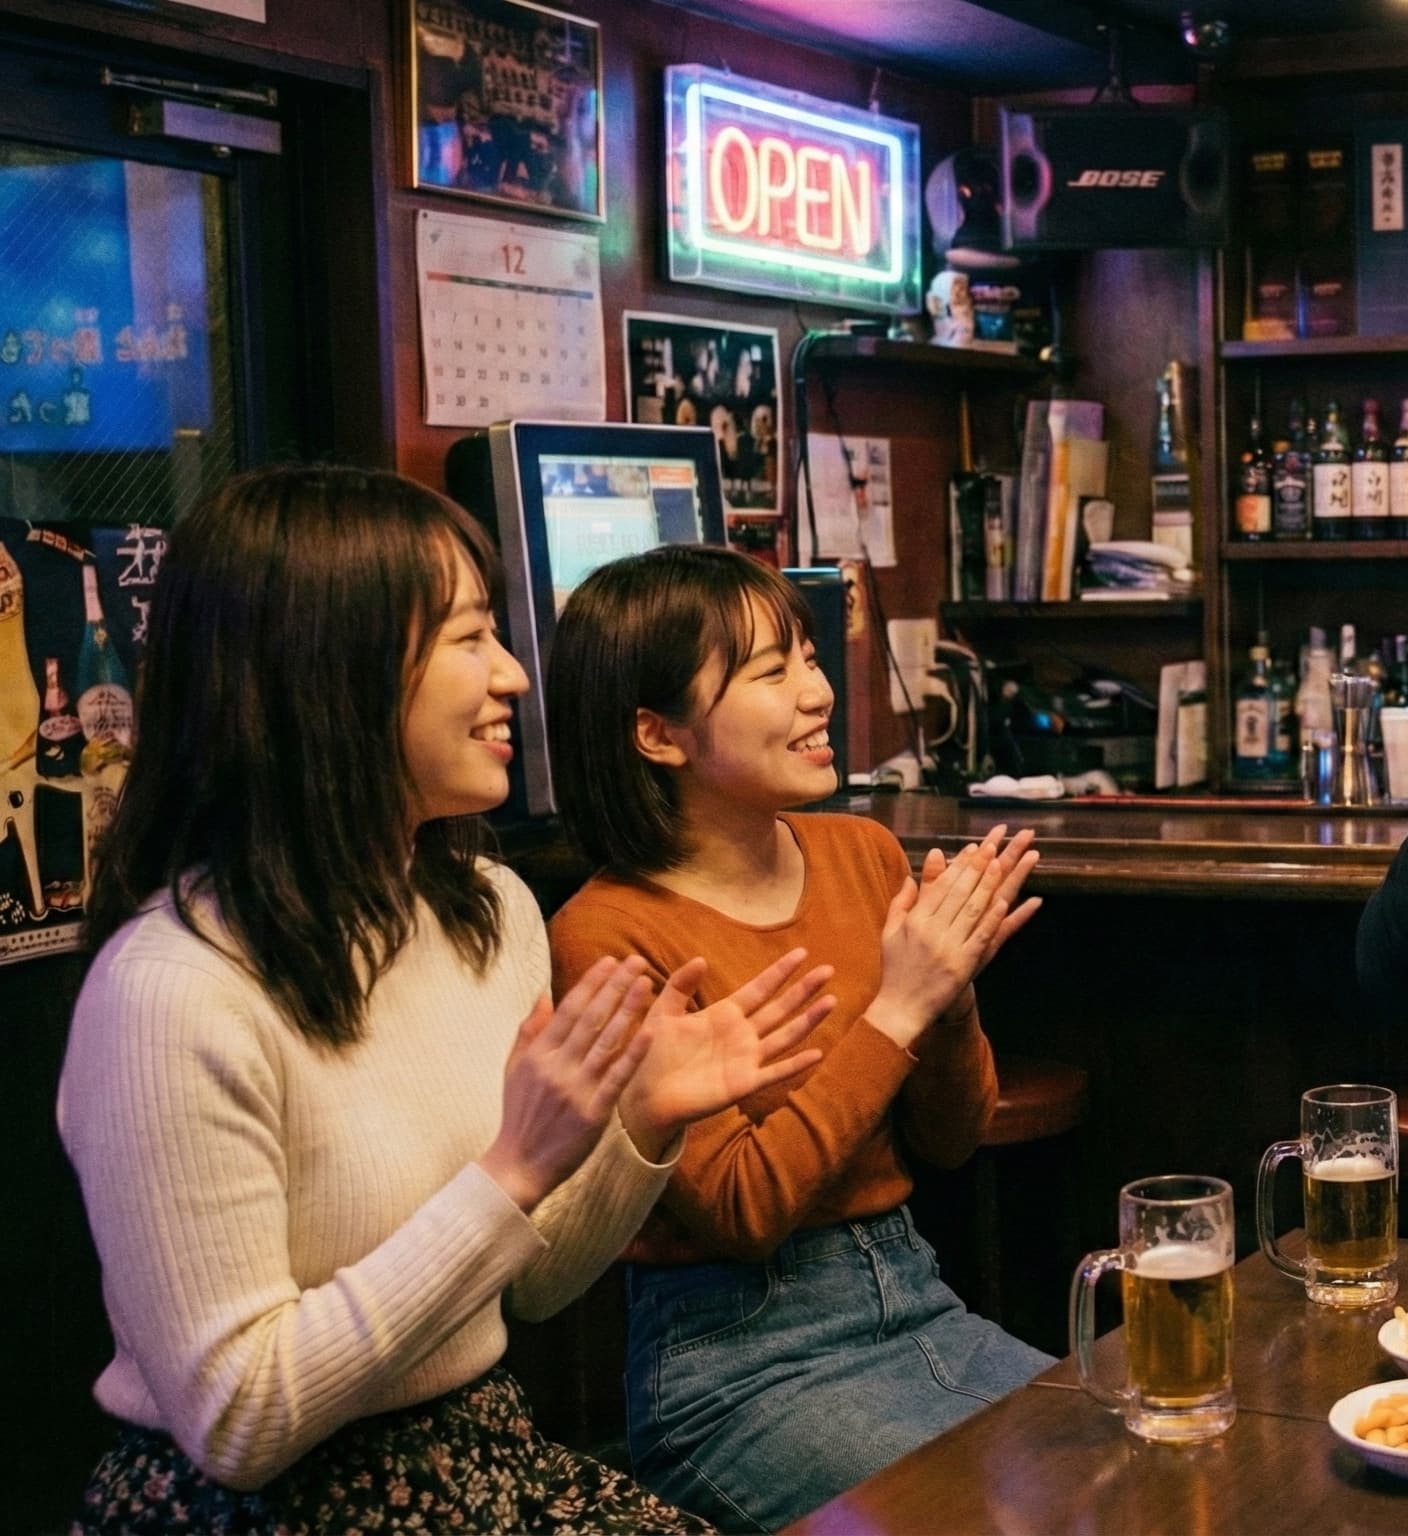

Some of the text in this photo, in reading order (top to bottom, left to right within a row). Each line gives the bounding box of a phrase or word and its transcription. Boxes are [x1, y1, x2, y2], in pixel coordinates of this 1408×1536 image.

[709, 126, 871, 255] OPEN
[1066, 170, 1164, 188] BOSE
[501, 244, 527, 275] 12
